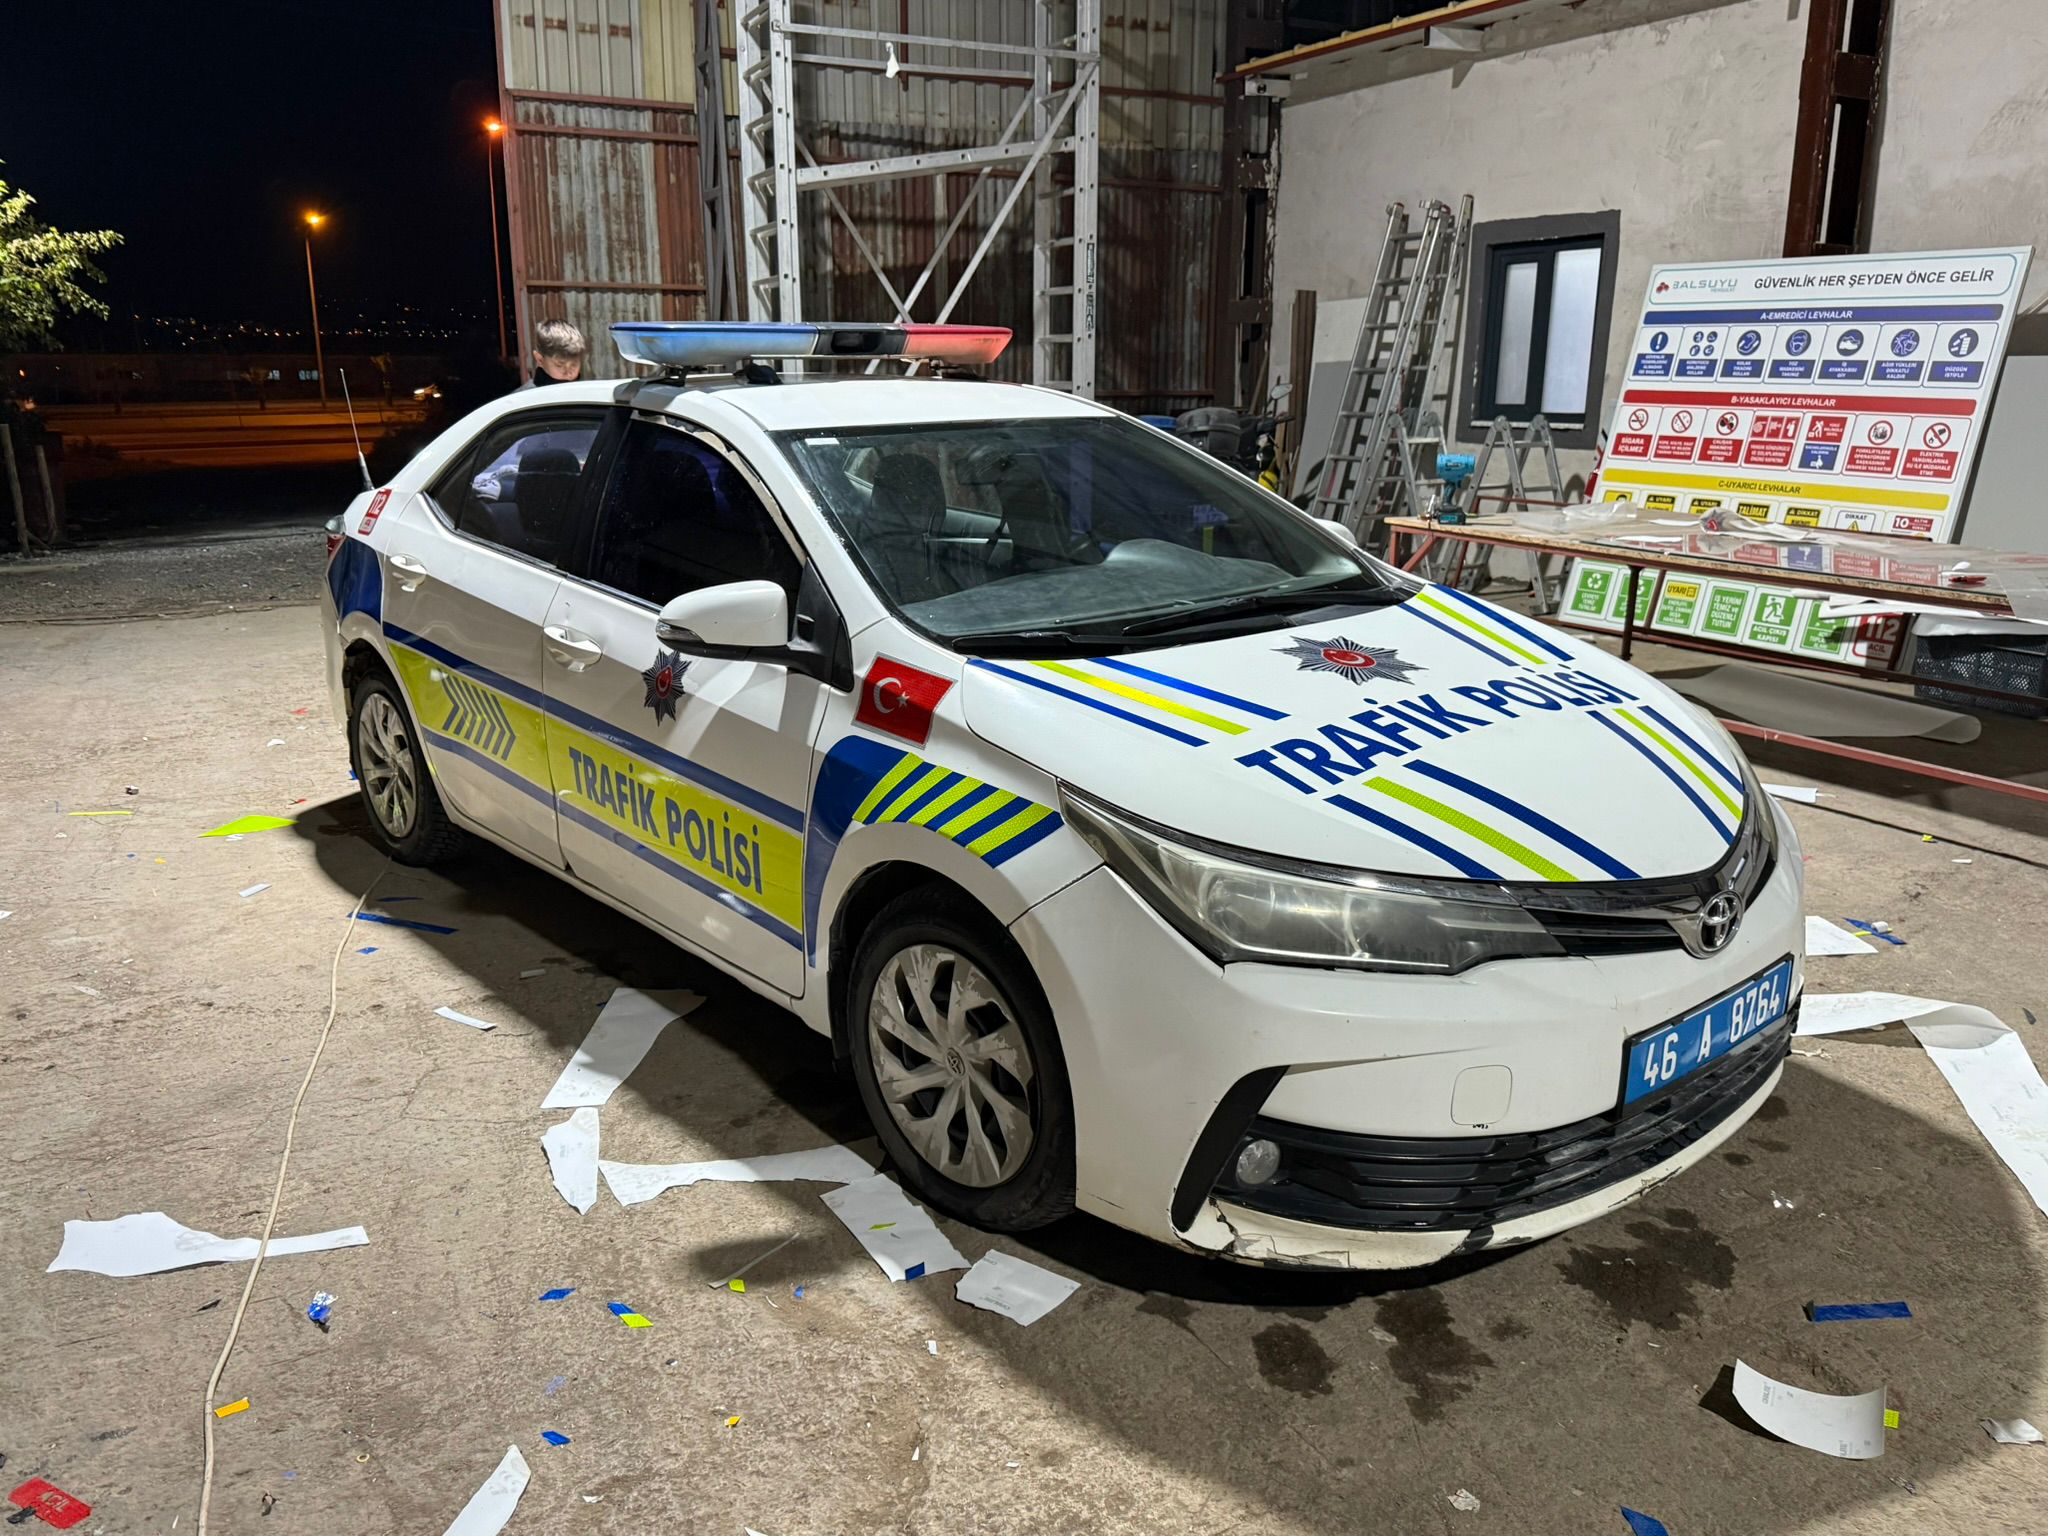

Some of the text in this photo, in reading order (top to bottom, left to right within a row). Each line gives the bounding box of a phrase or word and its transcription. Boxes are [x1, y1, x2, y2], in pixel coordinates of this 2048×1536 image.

[1755, 268, 1994, 289] GÜVENLİK HER ŞEYDEN ÖNCE GELİR
[1808, 311, 1853, 319] LEVHALAR
[1792, 398, 1837, 407] LEVHALAR
[1718, 480, 1801, 494] C-UYARICI LEVHALAR
[1895, 517, 1909, 529] 10
[1865, 615, 1901, 641] 112
[1234, 663, 1640, 795] TRAFİK POLİSİ
[568, 746, 763, 895] TRAFİK POLİSİ
[1643, 974, 1780, 1088] 46 A 8764
